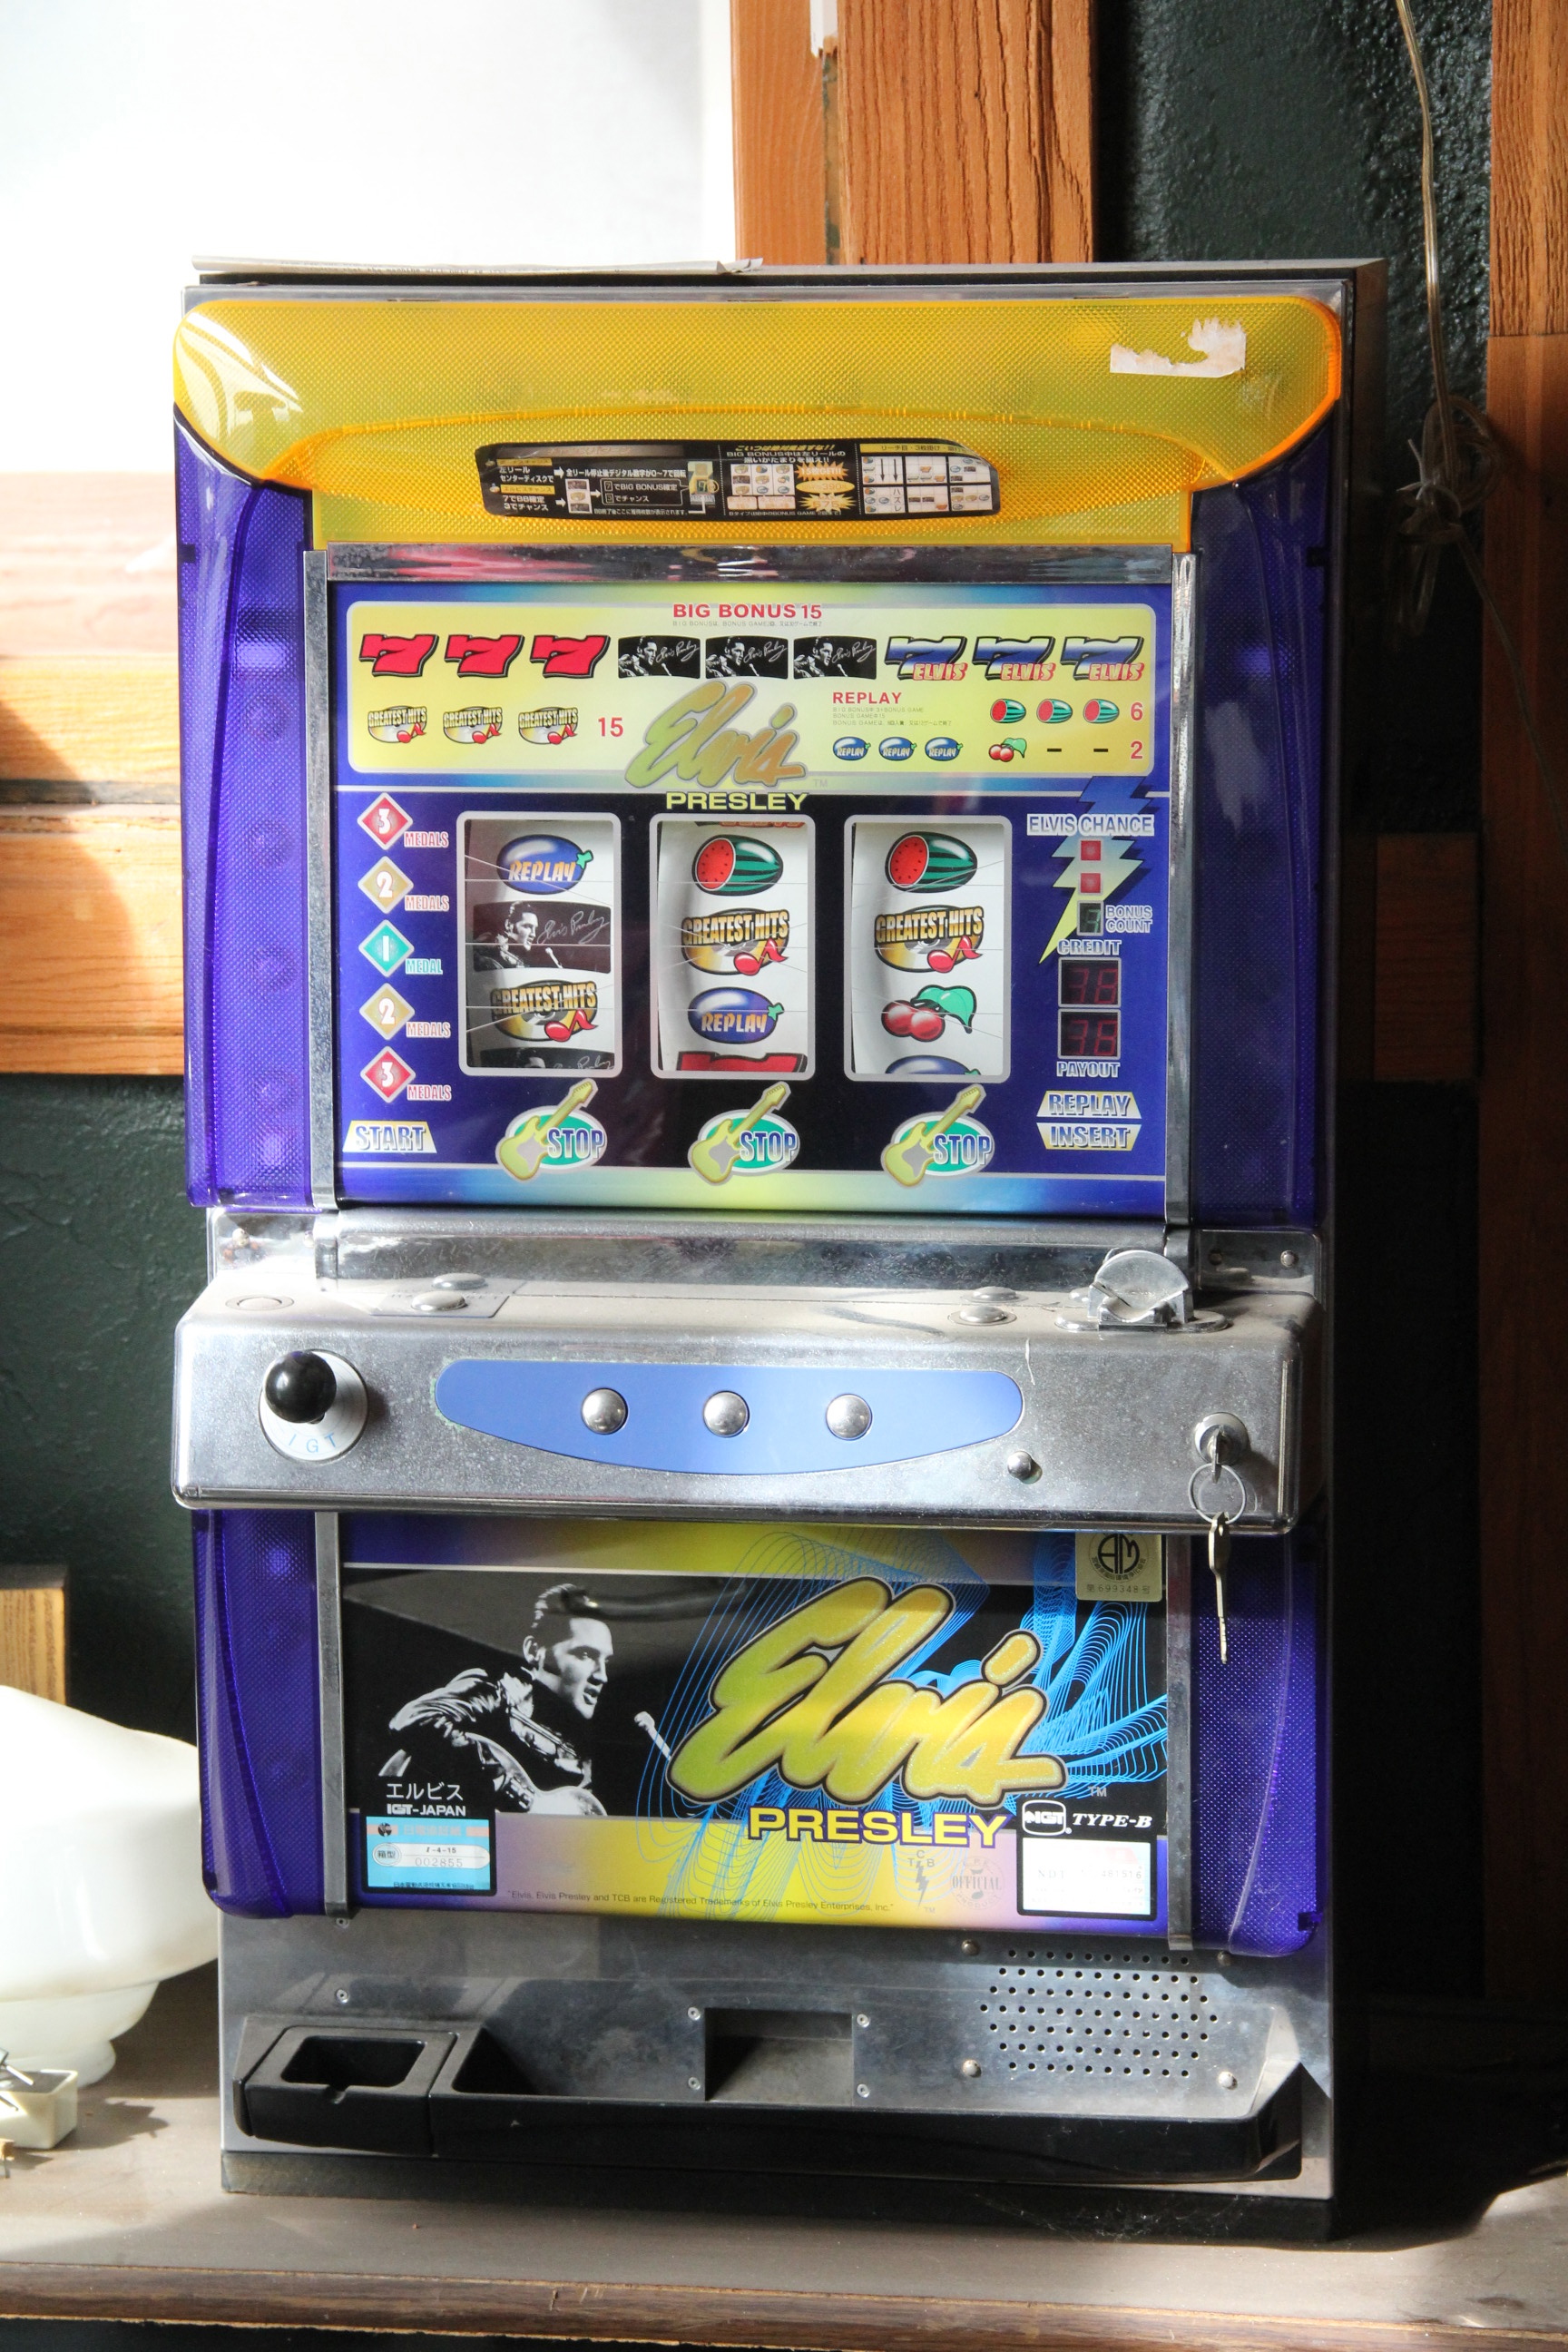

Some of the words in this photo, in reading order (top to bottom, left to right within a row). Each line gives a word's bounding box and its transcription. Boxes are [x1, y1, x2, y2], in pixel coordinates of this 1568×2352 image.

[500, 475, 554, 483] センターディスクで
[505, 503, 549, 511] 3でチャンス
[673, 603, 710, 618] BIG
[719, 603, 796, 618] BONUS
[801, 604, 822, 619] 15
[358, 633, 438, 678] 7
[444, 633, 524, 678] 7
[530, 633, 611, 678] 7
[912, 662, 968, 681] ELVIS
[1001, 662, 1057, 681] ELVIS
[1089, 662, 1145, 681] ELVIS
[833, 692, 902, 704] REPLAY
[368, 709, 407, 727] GREATEST
[408, 707, 426, 723] HITS
[444, 710, 483, 728] GREATEST
[483, 708, 502, 724] HITS
[519, 710, 558, 728] GREATEST
[558, 708, 578, 725] HITS
[1131, 703, 1143, 720] 6
[598, 717, 623, 737] 15
[624, 681, 807, 789] Elvis
[837, 747, 864, 757] REPLAY
[882, 747, 910, 757] REPLAY
[928, 747, 956, 757] REPLAY
[1131, 741, 1143, 759] 2
[813, 779, 828, 788] TM
[666, 791, 809, 810] PRESLEY
[377, 808, 392, 834] 3
[404, 832, 448, 848] MEDALS
[1028, 815, 1076, 834] ELVIS
[1080, 815, 1153, 834] CHANCE
[509, 861, 575, 882] REPLAY
[377, 871, 393, 898] 2
[405, 895, 449, 911] MEDALS
[1106, 906, 1152, 919] BONUS
[682, 915, 754, 945] GREATEST
[754, 909, 790, 939] HITS
[876, 911, 946, 943] GREATEST
[947, 906, 984, 936] HITS
[1106, 919, 1152, 933] COUNT
[382, 935, 390, 962] 1
[406, 958, 443, 975] MEDAL
[1057, 939, 1122, 955] CREDIT
[492, 985, 562, 1017] GREATEST
[562, 981, 597, 1009] HITS
[378, 997, 396, 1024] 2
[406, 1022, 451, 1037] MEDALS
[701, 1014, 767, 1033] REPLAY
[1056, 1062, 1120, 1078] PAYOUT
[381, 1062, 393, 1087] 3
[407, 1085, 452, 1102] MEDALS
[1048, 1093, 1131, 1116] REPLAY
[355, 1126, 426, 1152] START
[547, 1128, 605, 1159] STOP
[740, 1132, 797, 1161] STOP
[1050, 1126, 1131, 1149] INSERT
[933, 1134, 991, 1165] STOP
[289, 1433, 336, 1453] IGT
[667, 1575, 1068, 1808] Elvis
[387, 1782, 464, 1801] エルビス
[1088, 1786, 1107, 1798] TM
[387, 1803, 466, 1817] IGT-JAPAN
[1073, 1812, 1153, 1828] TYPE-B
[748, 1806, 1014, 1850] PRESLEY
[415, 1857, 464, 1867] 002855
[952, 1875, 1002, 1890] OFFICIAL
[536, 1891, 556, 1900] Elvis
[559, 1892, 591, 1903] Presley
[593, 1894, 609, 1902] and
[612, 1894, 630, 1902] TCB
[650, 1895, 697, 1906] Registered
[701, 1896, 750, 1906] Trademarks
[752, 1898, 760, 1906] of
[763, 1899, 783, 1907] Elvis
[786, 1900, 818, 1910] Presley
[821, 1902, 873, 1912] Enterprises,
